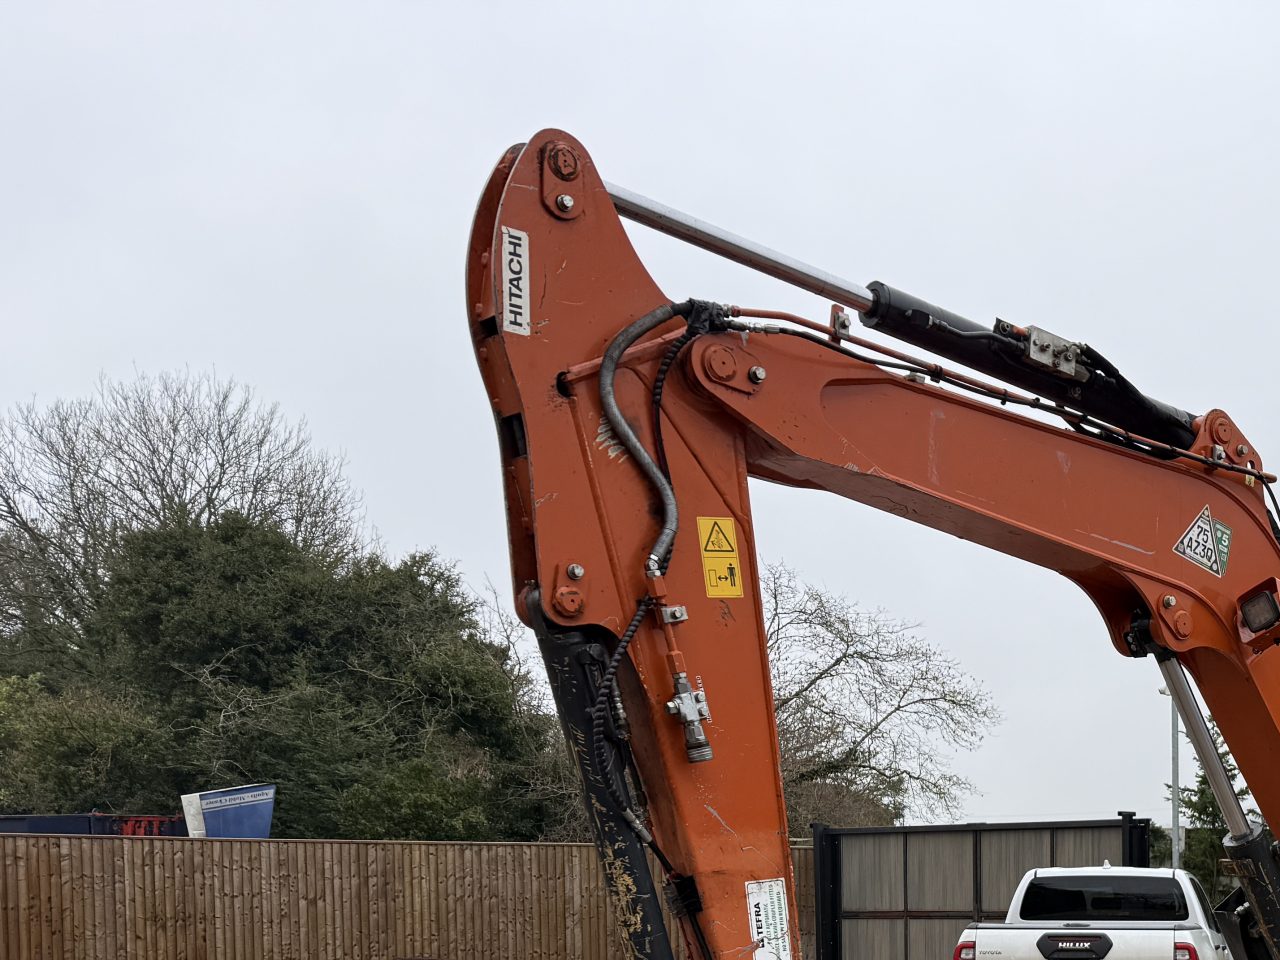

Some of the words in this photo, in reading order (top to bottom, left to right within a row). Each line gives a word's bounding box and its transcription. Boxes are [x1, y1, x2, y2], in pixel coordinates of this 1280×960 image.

[508, 233, 523, 327] HITACHI
[1197, 524, 1210, 544] 75
[1221, 533, 1229, 546] 5
[754, 902, 764, 937] TEFRA
[1058, 941, 1091, 949] HILUX
